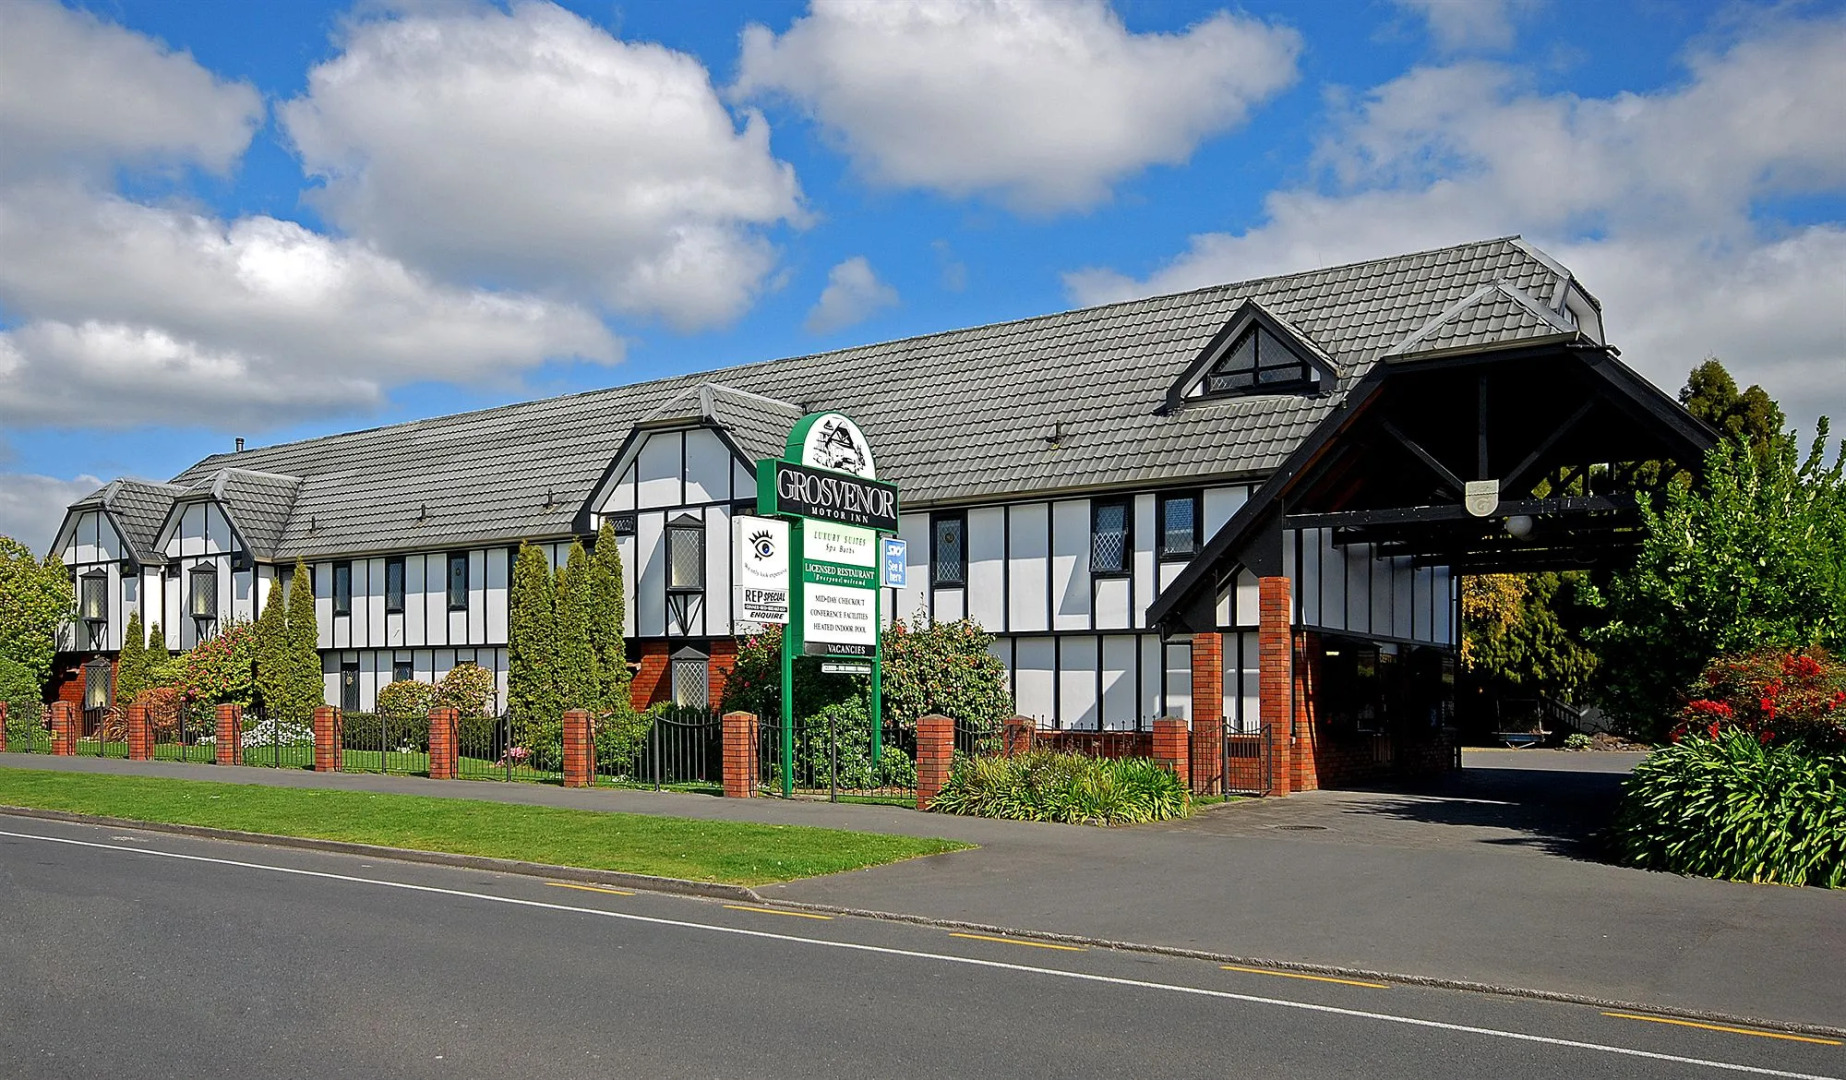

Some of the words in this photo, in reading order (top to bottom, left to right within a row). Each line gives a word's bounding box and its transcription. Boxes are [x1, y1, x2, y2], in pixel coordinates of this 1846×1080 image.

[777, 469, 896, 520] GROSVENOR
[812, 506, 846, 519] MOTOR
[851, 513, 868, 524] INN
[814, 531, 840, 542] LUXURY
[844, 536, 866, 547] SUITES
[826, 543, 836, 553] Spa
[805, 563, 836, 576] LICENSED
[837, 567, 875, 580] RESTAURANT
[888, 560, 898, 572] See
[890, 572, 902, 582] here
[745, 589, 763, 603] REP
[764, 592, 786, 602] SPECIAL
[815, 595, 837, 604] MID-DAY
[838, 597, 865, 606] CHECKOUT
[750, 611, 784, 620] ENQUIRE
[810, 609, 842, 619] CONFERENCE
[843, 612, 869, 620] FACILITIES
[813, 622, 834, 631] HEATED
[835, 624, 854, 633] INDOOR
[827, 644, 866, 654] VACANCIES
